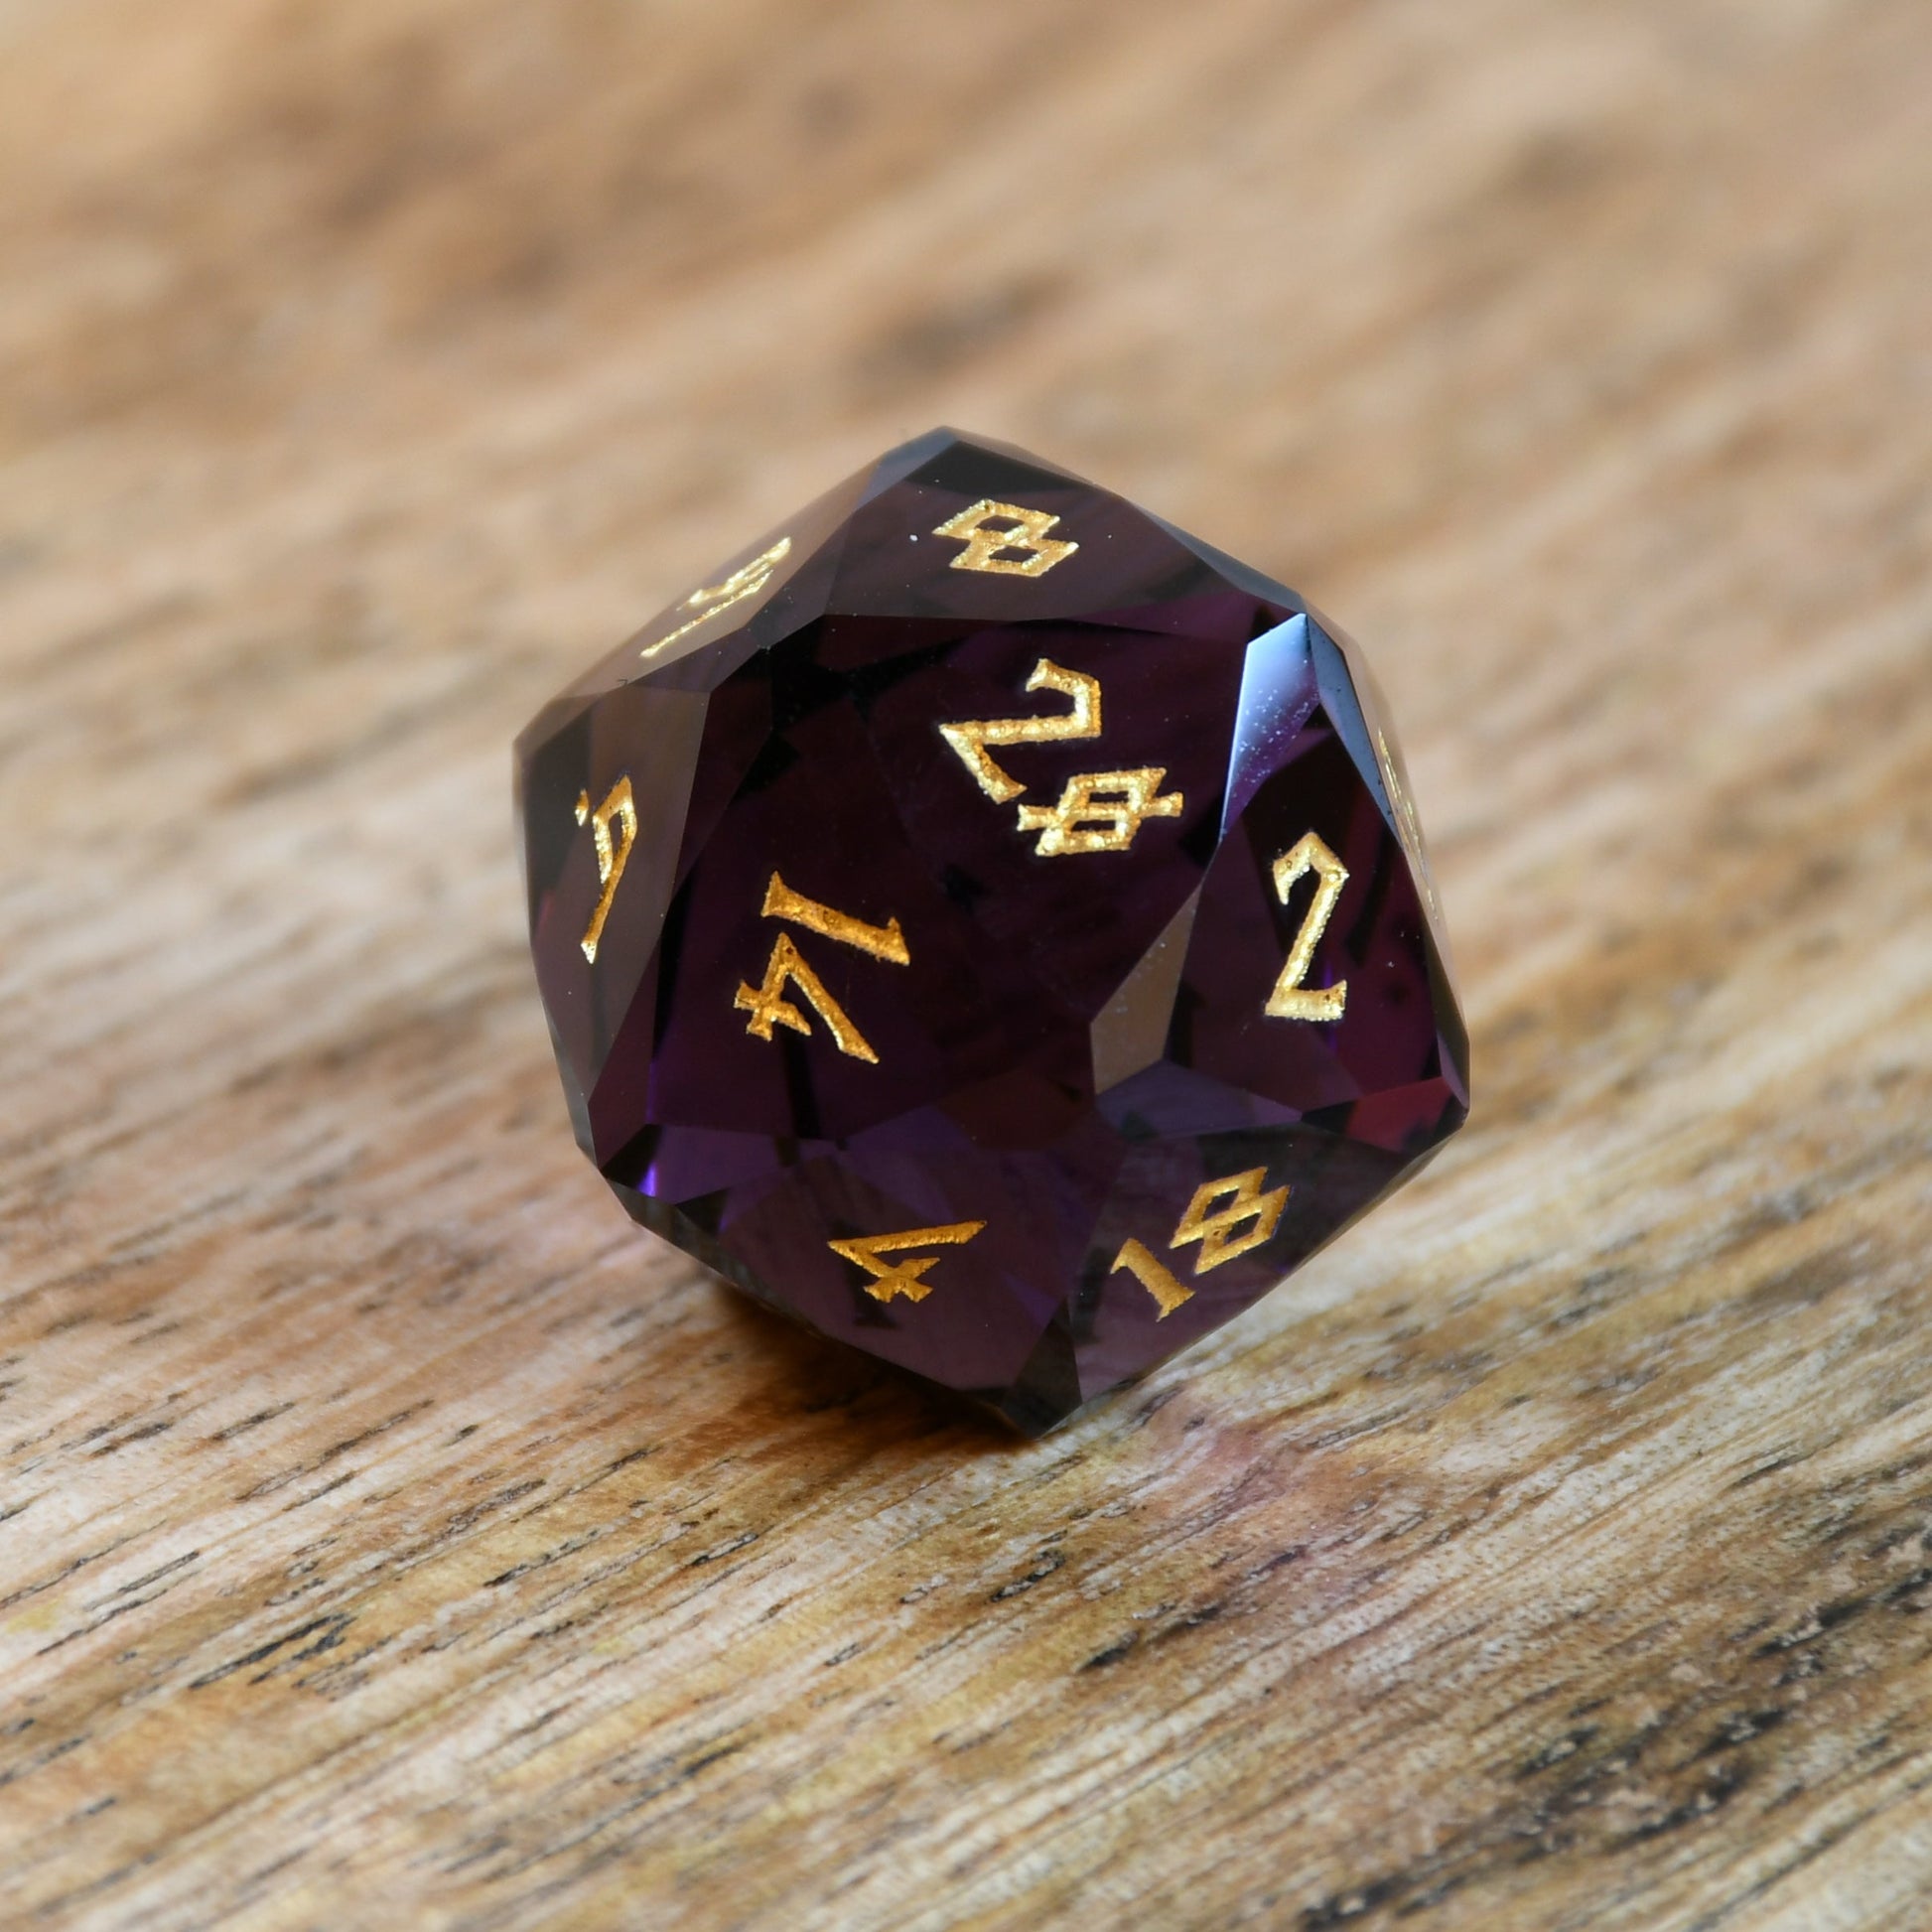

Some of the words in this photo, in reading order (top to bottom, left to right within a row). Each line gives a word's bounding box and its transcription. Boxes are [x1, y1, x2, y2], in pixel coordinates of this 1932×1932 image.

[935, 499, 1079, 578] 8
[1264, 831, 1350, 1023] 2
[828, 1220, 987, 1303] 4
[1111, 1166, 1291, 1322] 18
